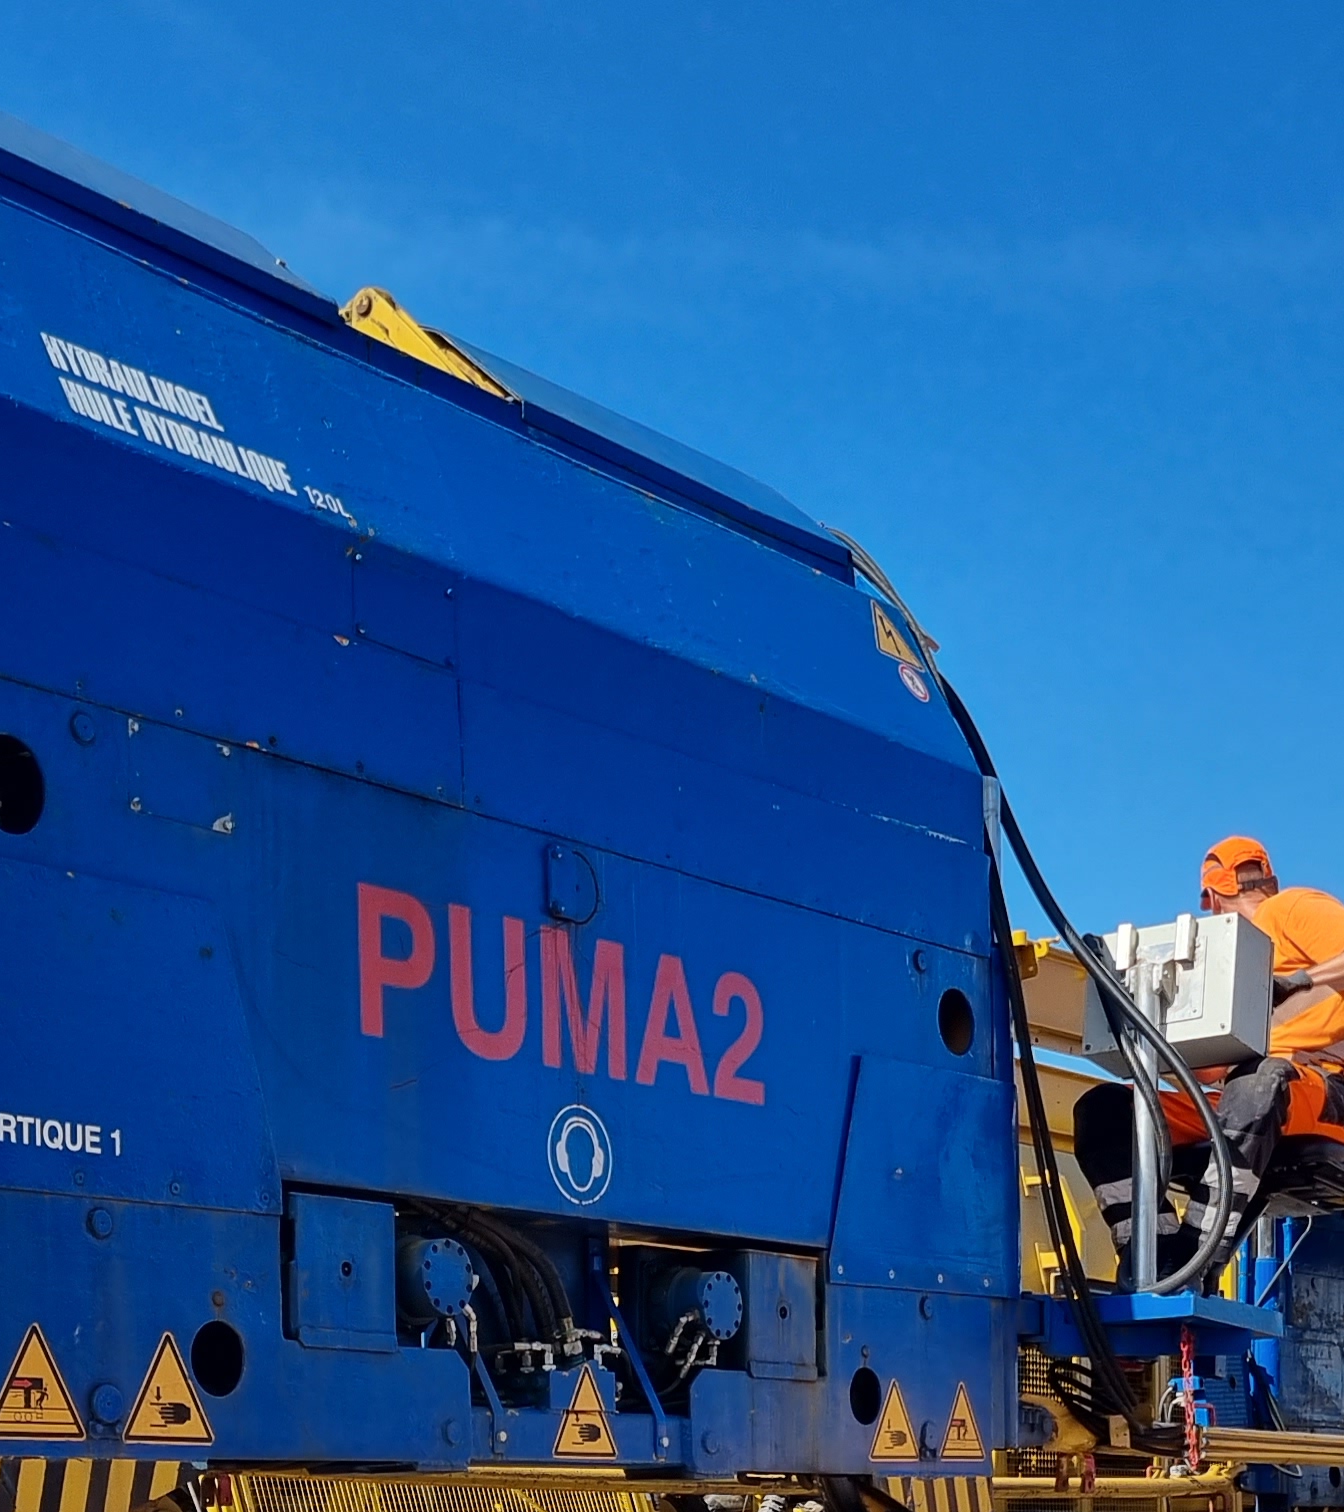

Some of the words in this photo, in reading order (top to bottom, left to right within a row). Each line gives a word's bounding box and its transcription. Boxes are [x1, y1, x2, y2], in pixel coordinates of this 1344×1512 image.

[40, 331, 225, 432] HYDRAULIKOEL
[58, 376, 140, 436] HUILE
[133, 406, 298, 497] HYDRAULIQUE
[356, 882, 765, 1106] PUMA2
[110, 1129, 123, 1156] 1
